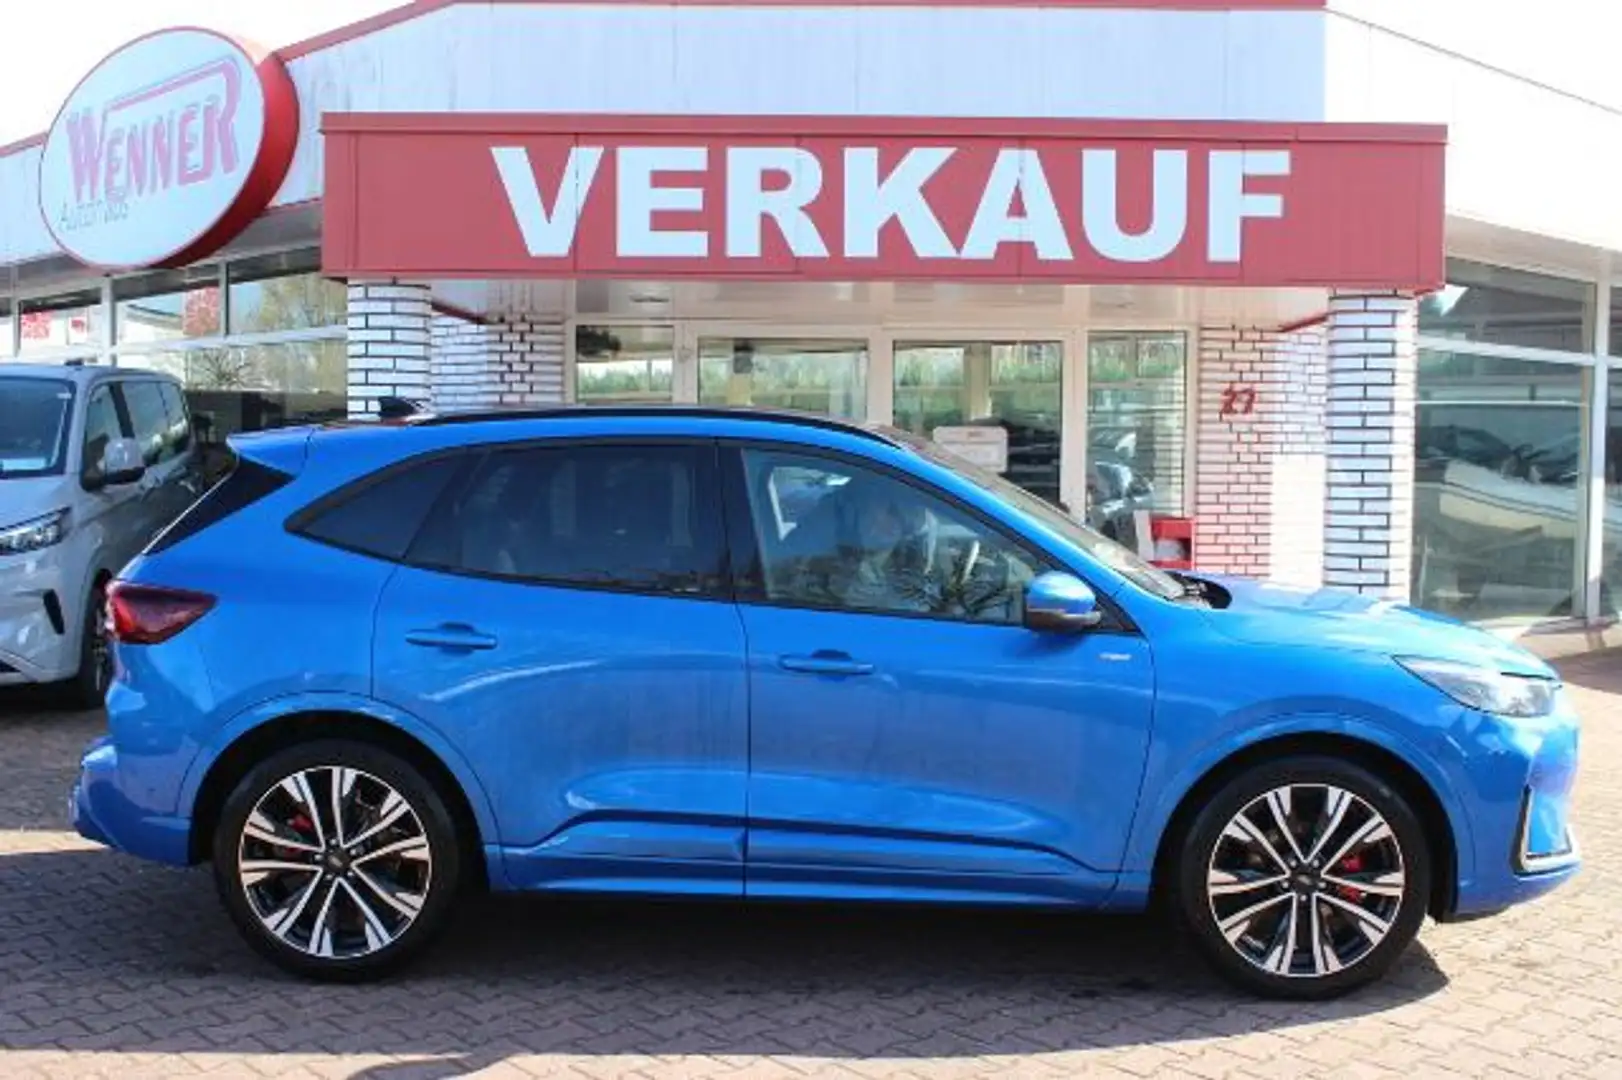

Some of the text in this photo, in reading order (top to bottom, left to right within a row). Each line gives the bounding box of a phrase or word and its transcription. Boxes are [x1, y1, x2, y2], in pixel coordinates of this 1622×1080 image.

[66, 54, 241, 203] WENNER
[490, 146, 1291, 263] VERKAUF
[1221, 386, 1256, 415] 27
